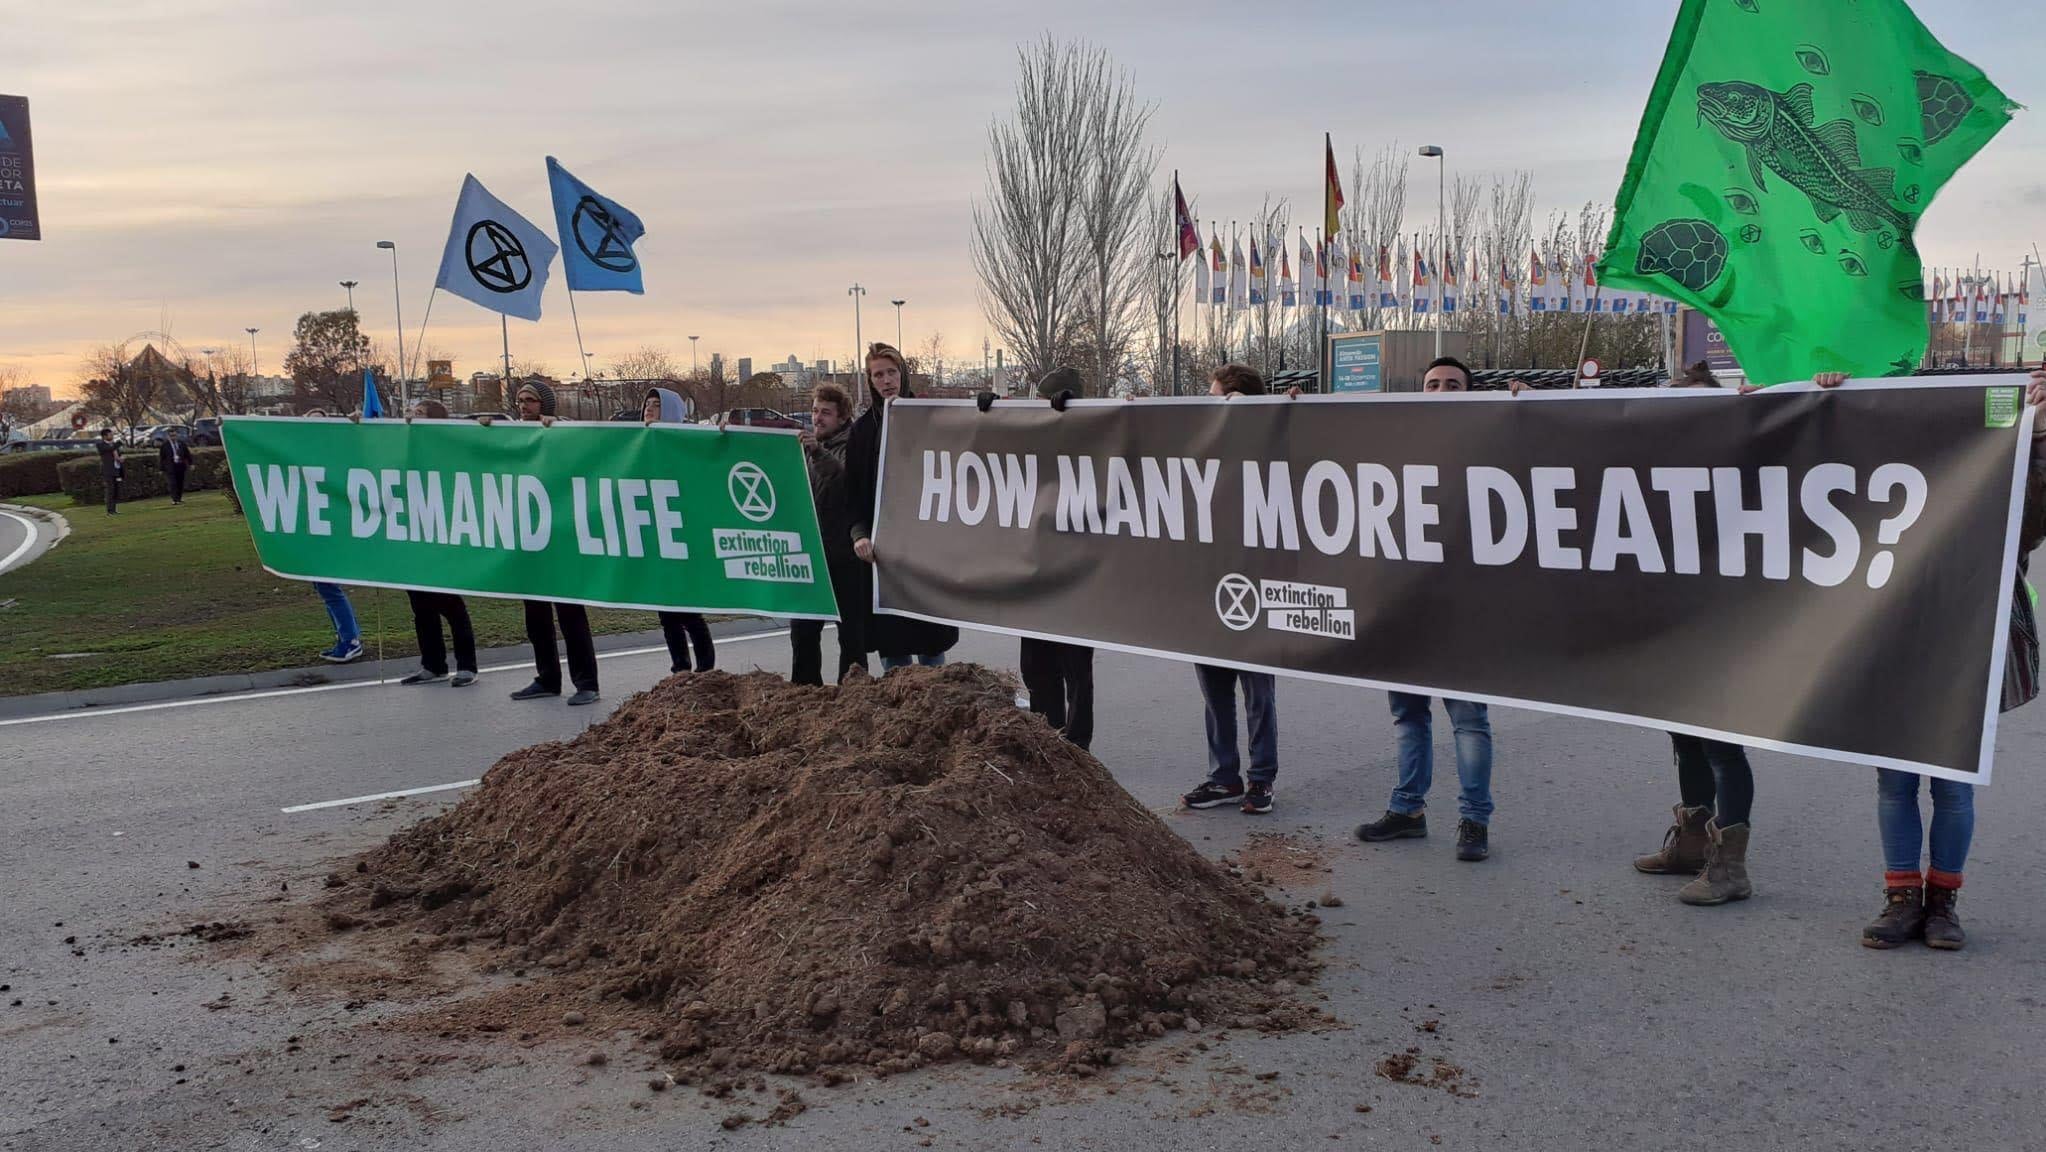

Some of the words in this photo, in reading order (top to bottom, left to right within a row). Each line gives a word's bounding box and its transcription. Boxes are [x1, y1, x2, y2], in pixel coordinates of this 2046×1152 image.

[246, 464, 332, 536] WE
[346, 468, 552, 552] DEMAND
[571, 477, 689, 560] LIFE
[918, 450, 1037, 529] HOW
[1055, 455, 1220, 543] MANY
[1242, 460, 1444, 563] MORE
[1466, 462, 1928, 589] DEATHS?
[719, 532, 790, 554] extinction
[744, 555, 810, 579] rebellion
[1265, 584, 1335, 608] extinction
[1286, 609, 1351, 636] rebellion
